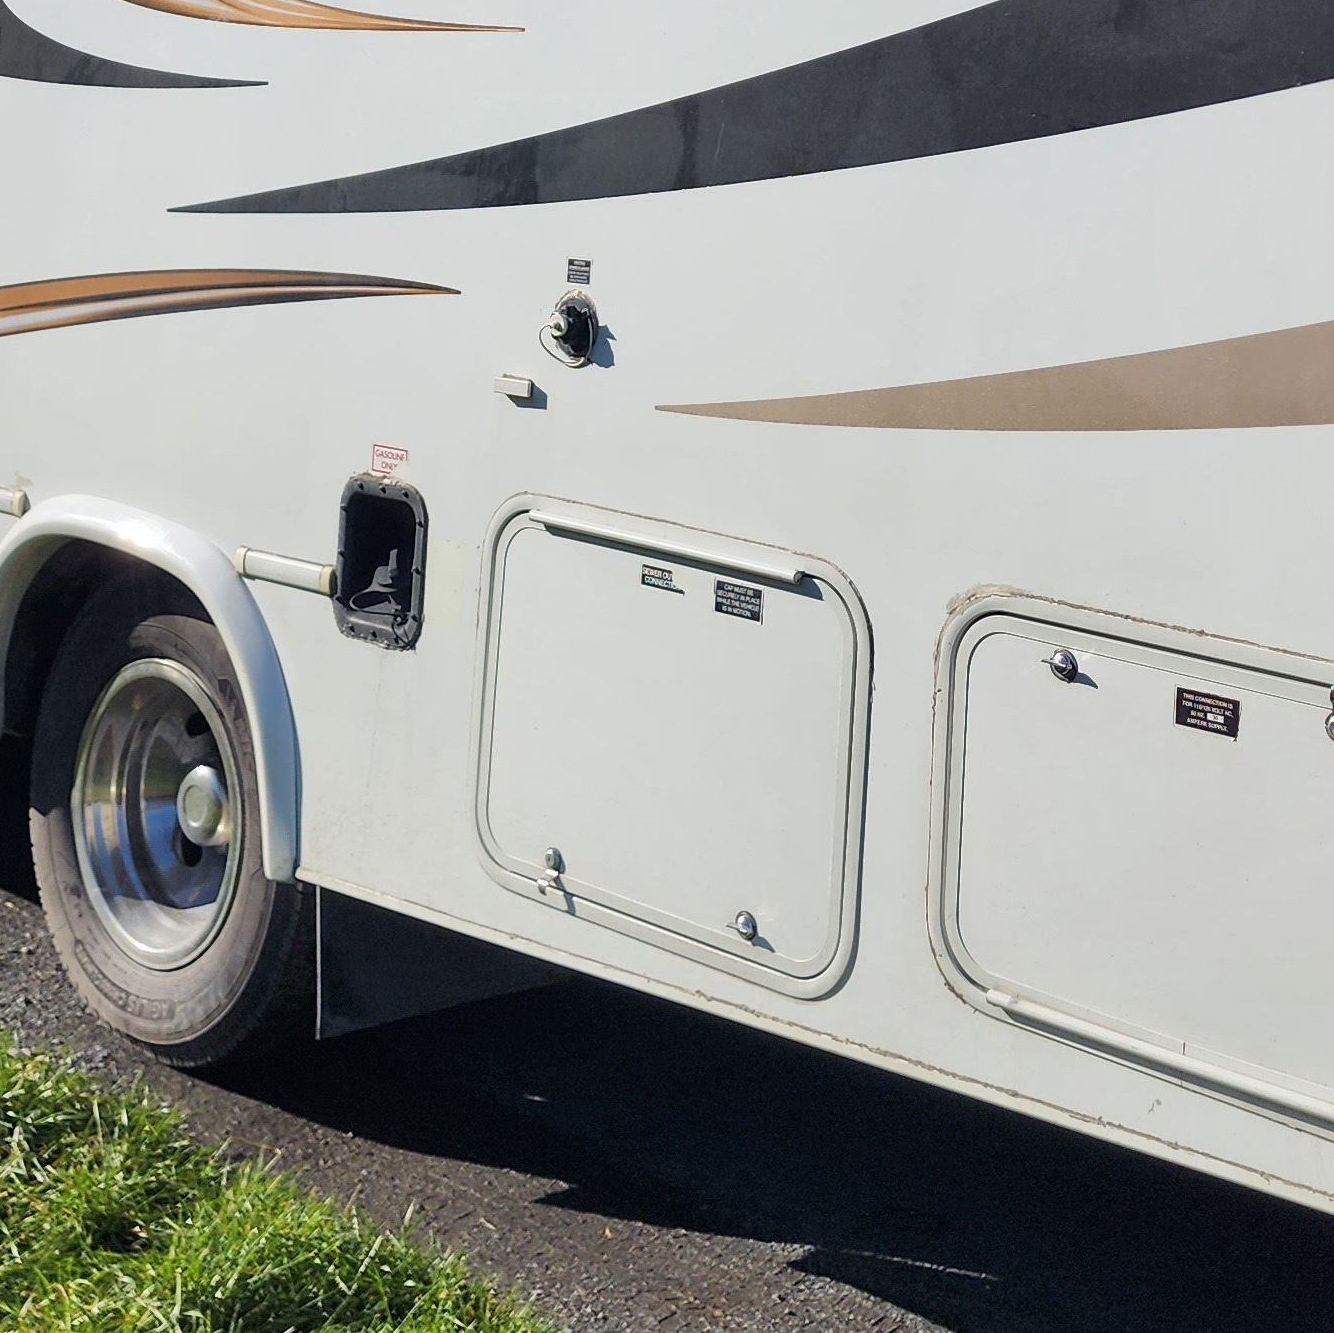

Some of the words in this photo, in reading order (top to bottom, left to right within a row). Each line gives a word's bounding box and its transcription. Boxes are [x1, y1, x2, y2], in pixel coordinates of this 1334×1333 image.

[642, 567, 663, 578] SEWER
[644, 576, 680, 590] CONNECTIO
[734, 586, 747, 595] MUST
[717, 589, 740, 599] SECURELY
[746, 596, 760, 605] PLACE
[717, 596, 731, 605] WHILE
[731, 599, 740, 607] THE
[740, 602, 760, 612] VEHICLE
[1194, 696, 1228, 707] CONNECTION
